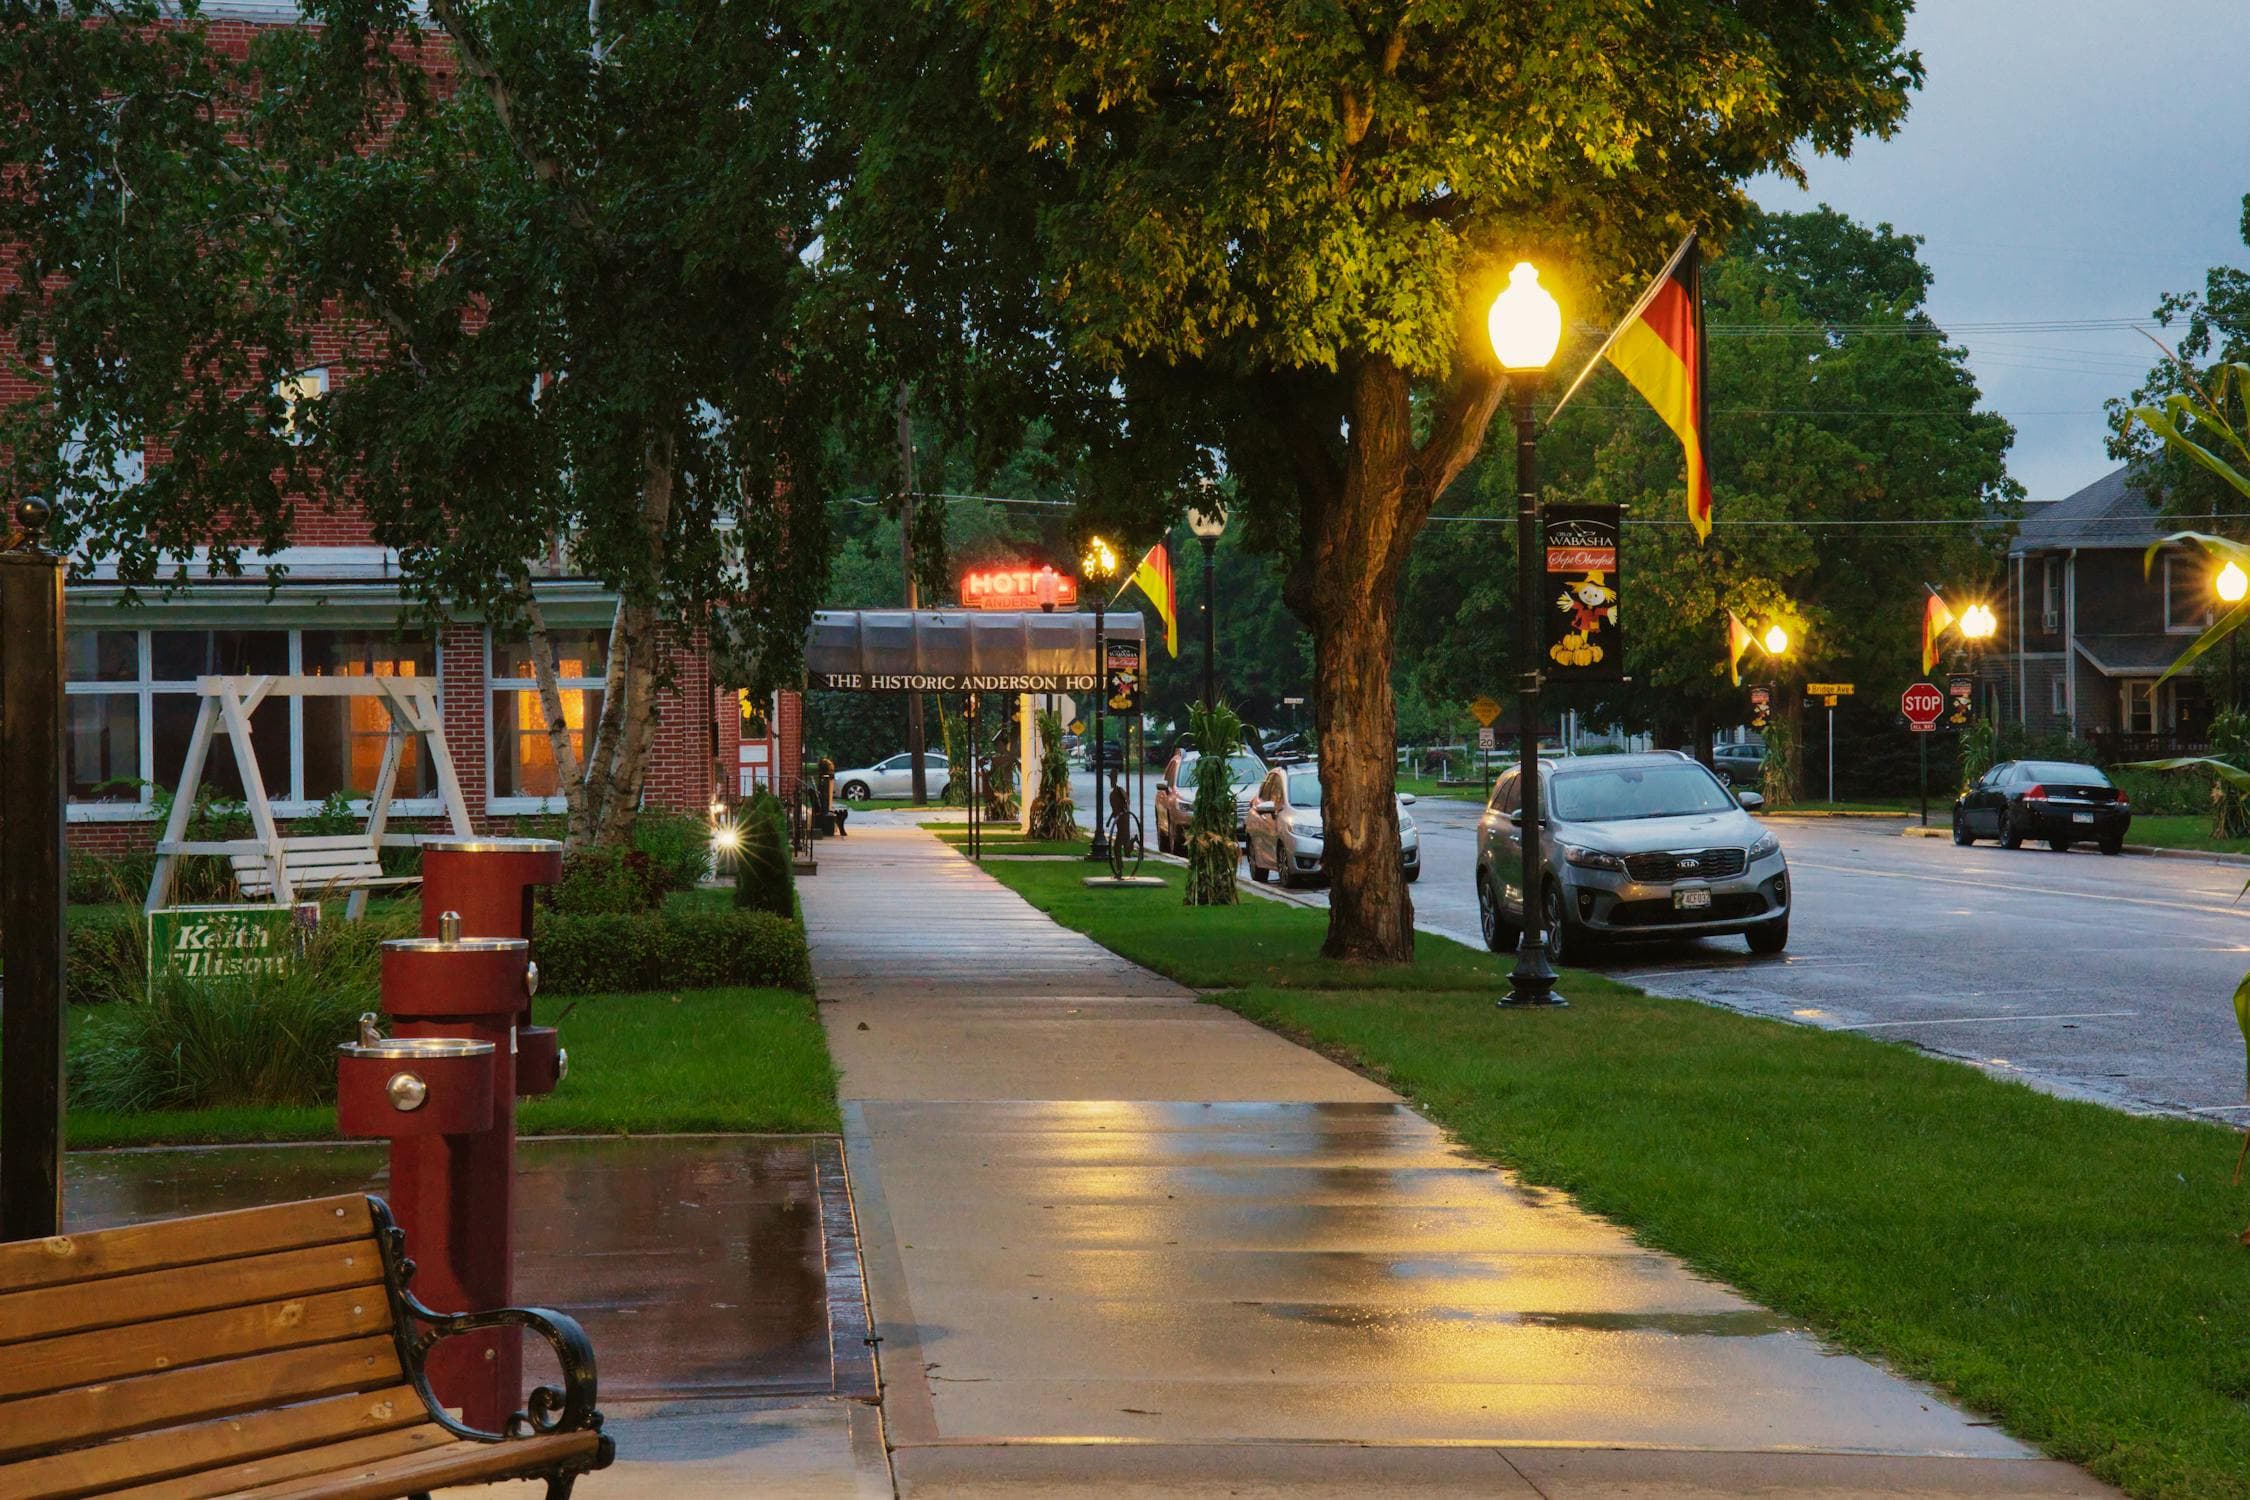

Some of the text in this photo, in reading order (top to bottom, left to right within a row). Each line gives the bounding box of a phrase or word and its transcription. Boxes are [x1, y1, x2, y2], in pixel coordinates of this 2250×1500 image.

[1549, 536, 1613, 546] WABASHA
[985, 597, 1040, 607] ANDERS
[826, 674, 1107, 690] THE HISTORIC ANDERSON HOU
[1905, 696, 1940, 711] STOP
[1480, 739, 1493, 747] 20
[175, 924, 269, 949] Keith
